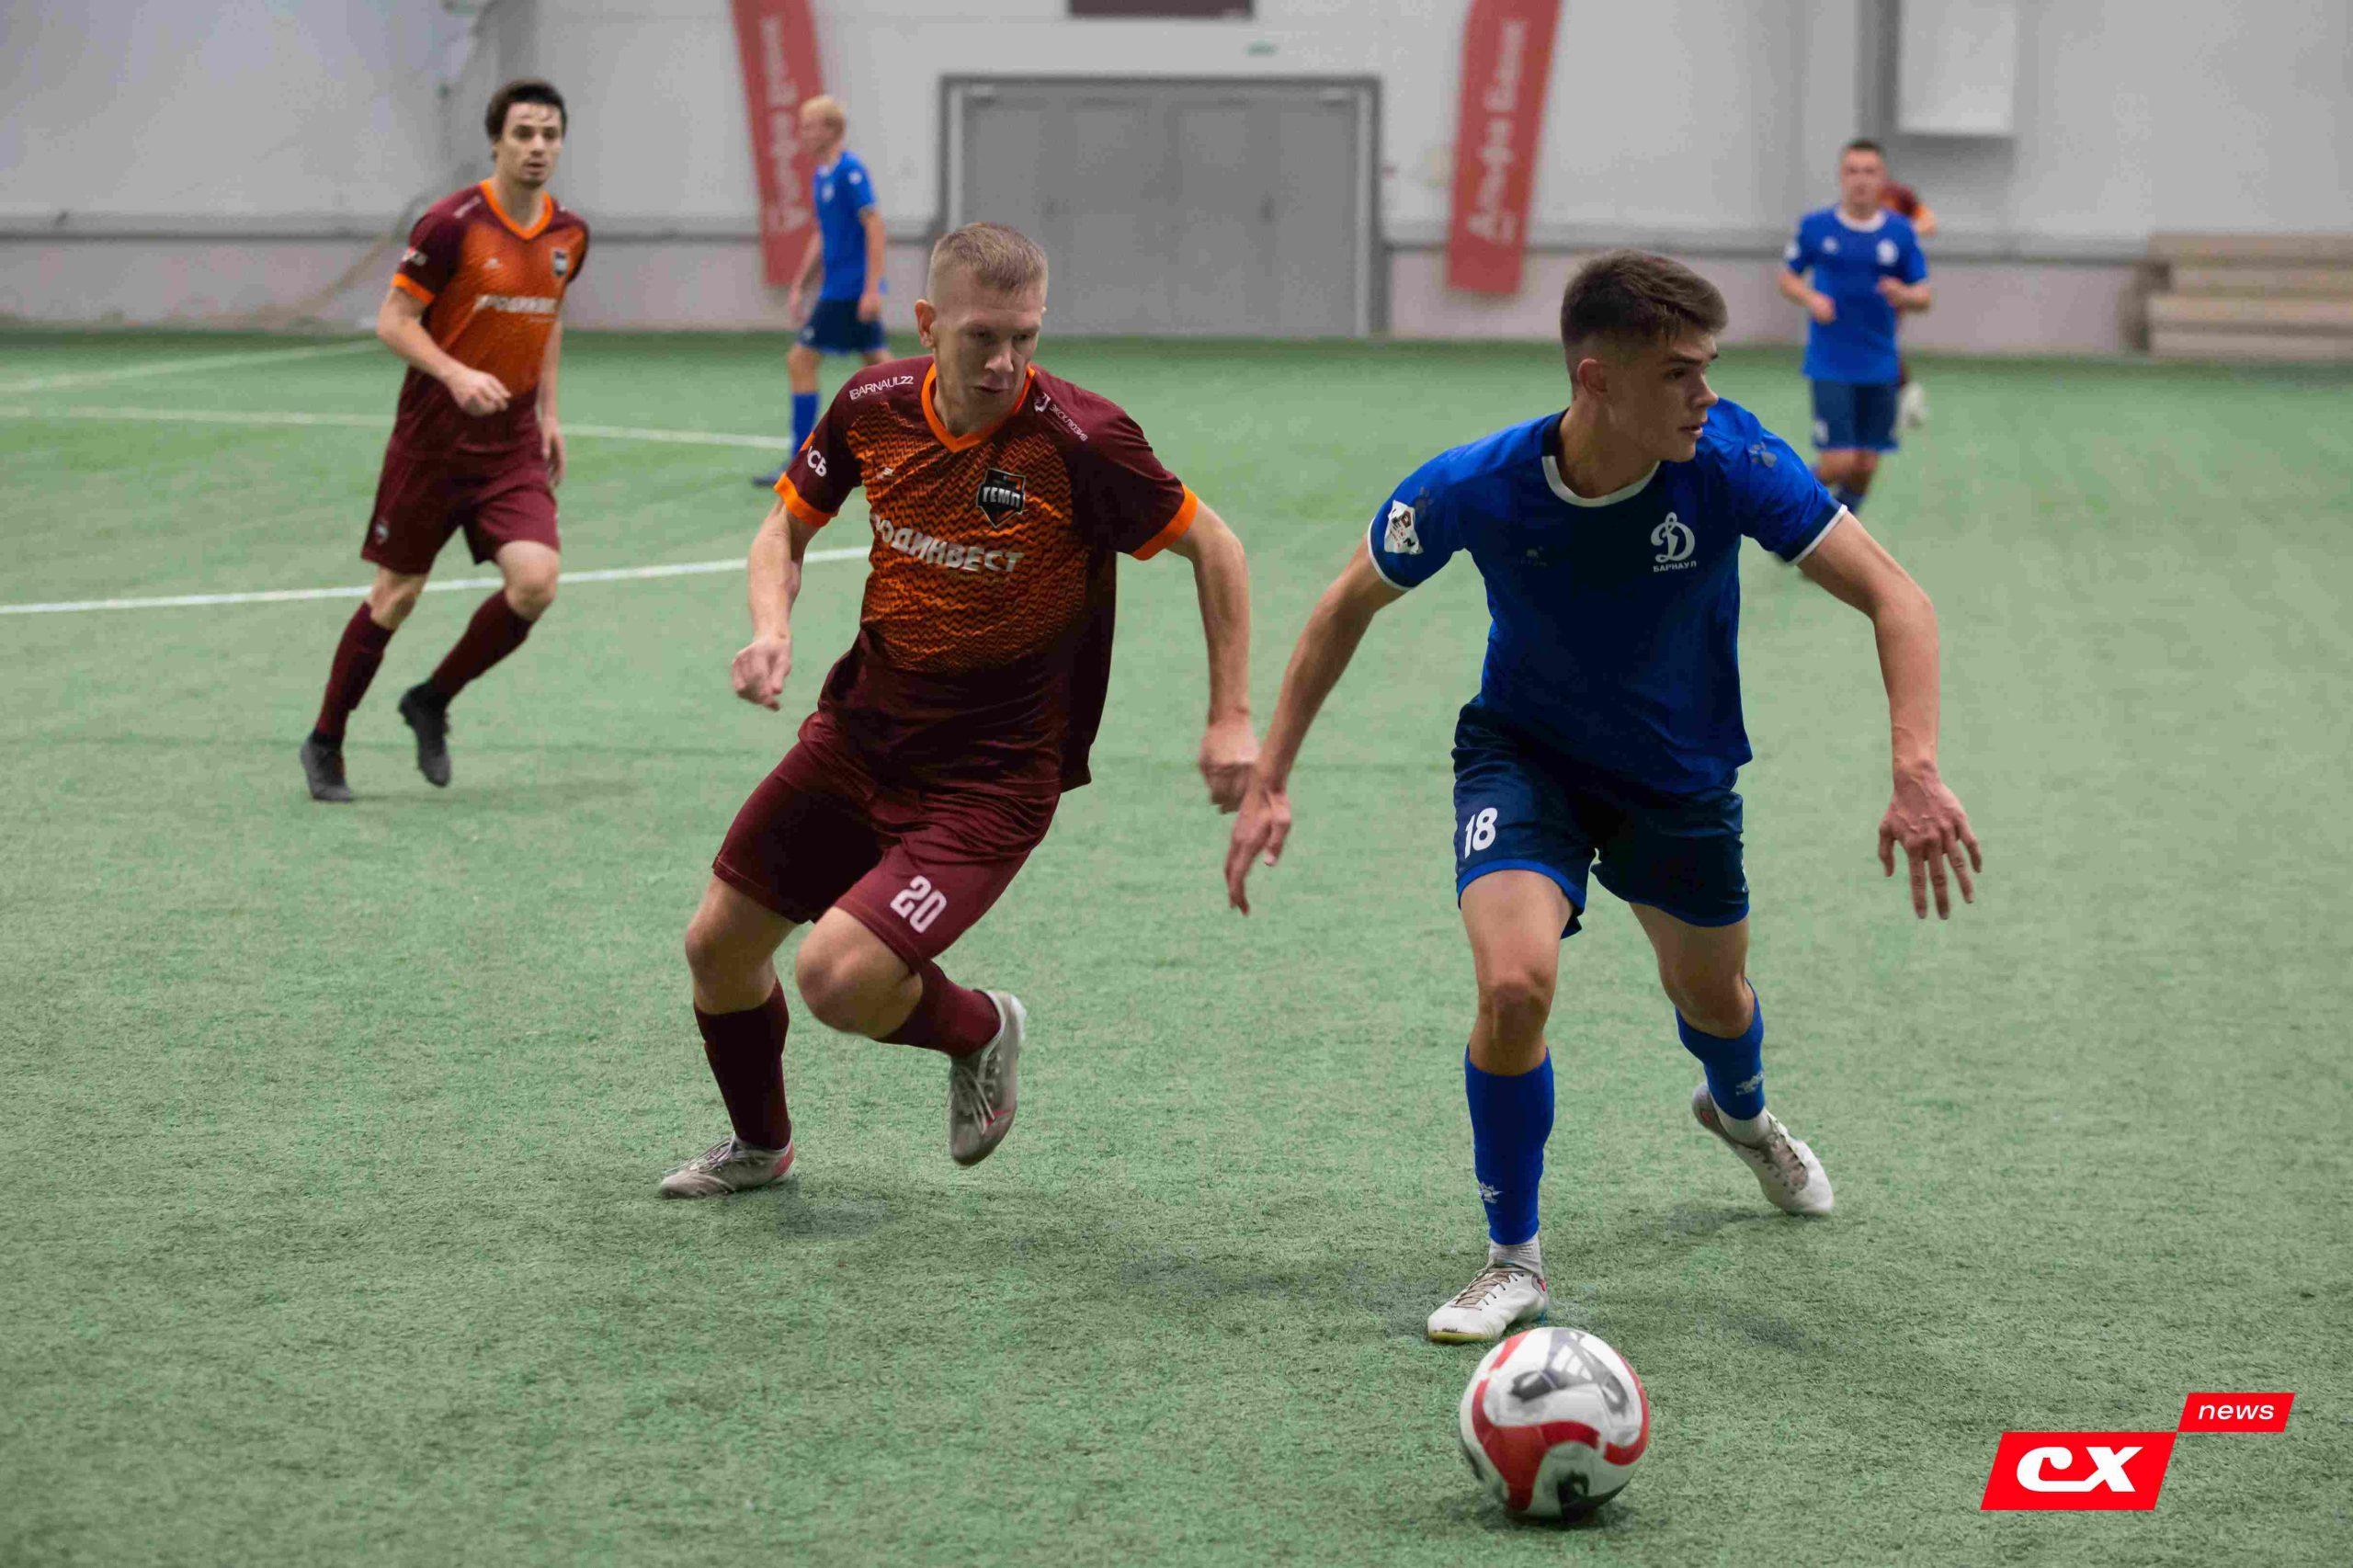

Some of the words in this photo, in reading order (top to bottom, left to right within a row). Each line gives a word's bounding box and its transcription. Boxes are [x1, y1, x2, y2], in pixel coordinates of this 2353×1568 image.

[807, 446, 827, 477] СБ
[1653, 561, 1698, 573] БАРНАУЛ
[1464, 807, 1498, 859] 18
[890, 875, 947, 934] 20
